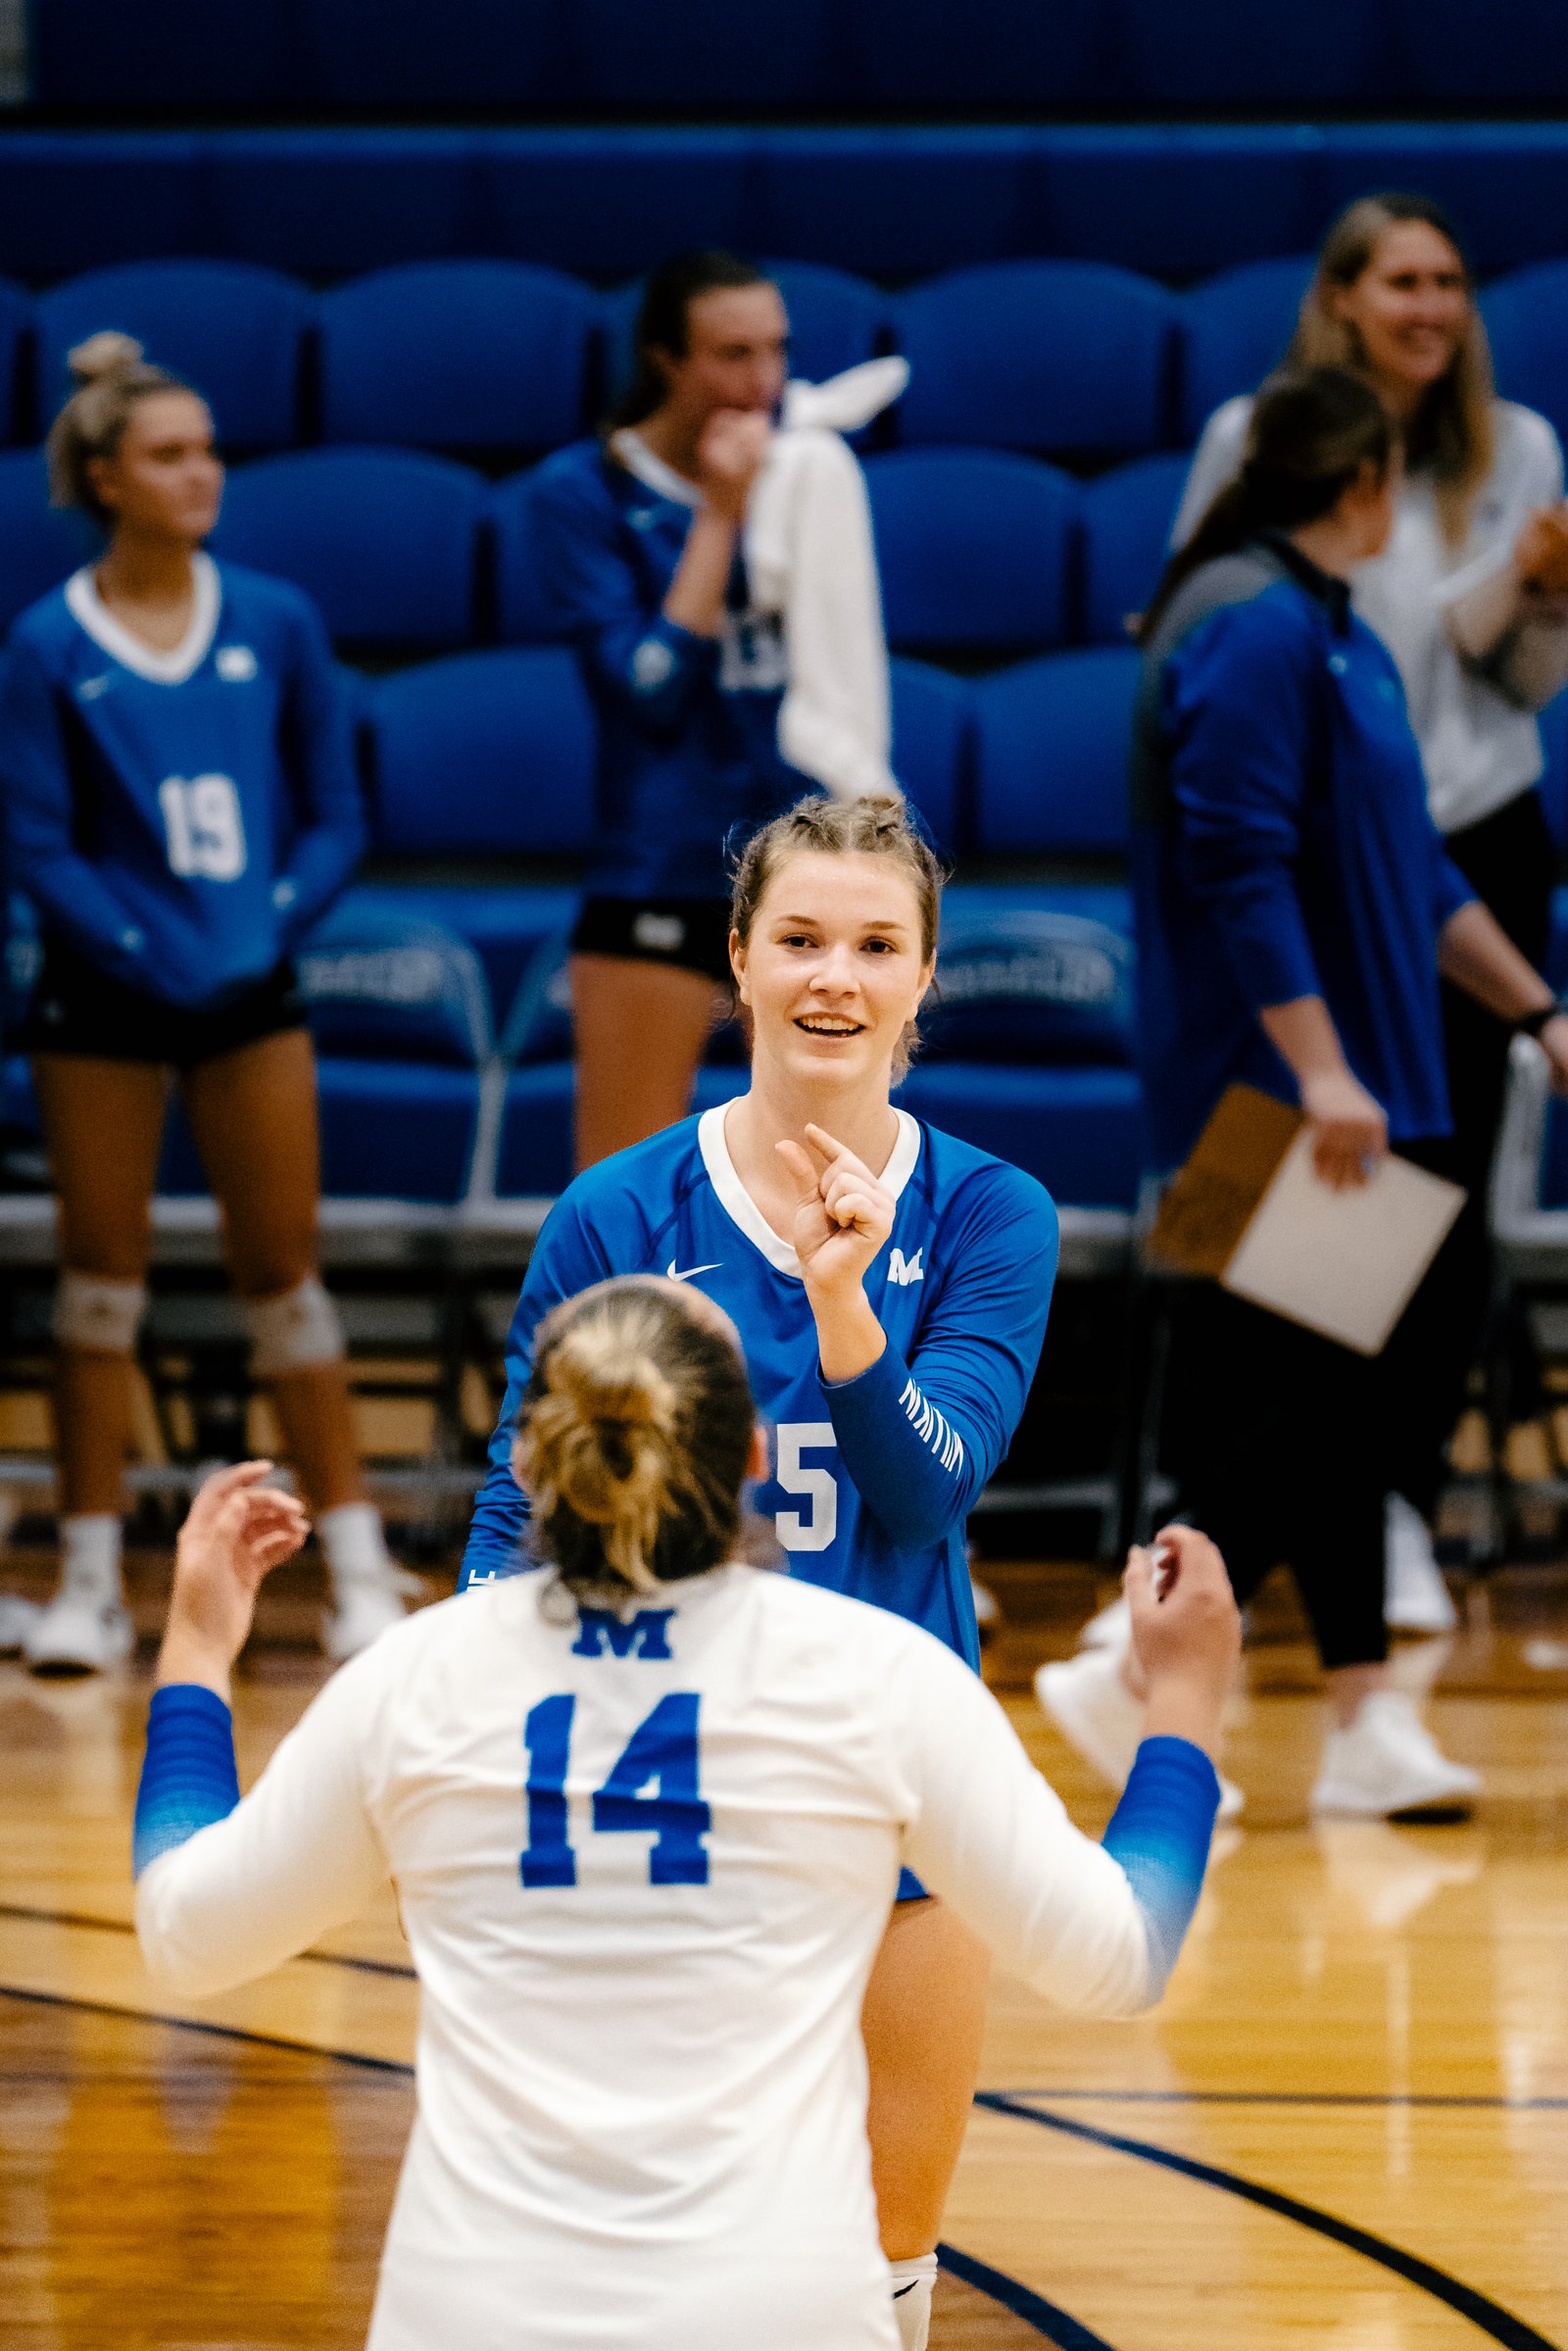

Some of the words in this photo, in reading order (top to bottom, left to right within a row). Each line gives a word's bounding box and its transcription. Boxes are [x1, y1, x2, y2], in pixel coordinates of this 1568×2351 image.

[158, 772, 248, 882] 19
[887, 1247, 924, 1286] M
[775, 1422, 837, 1551] 5
[571, 1607, 677, 1659] M
[518, 1691, 712, 1889] 14
